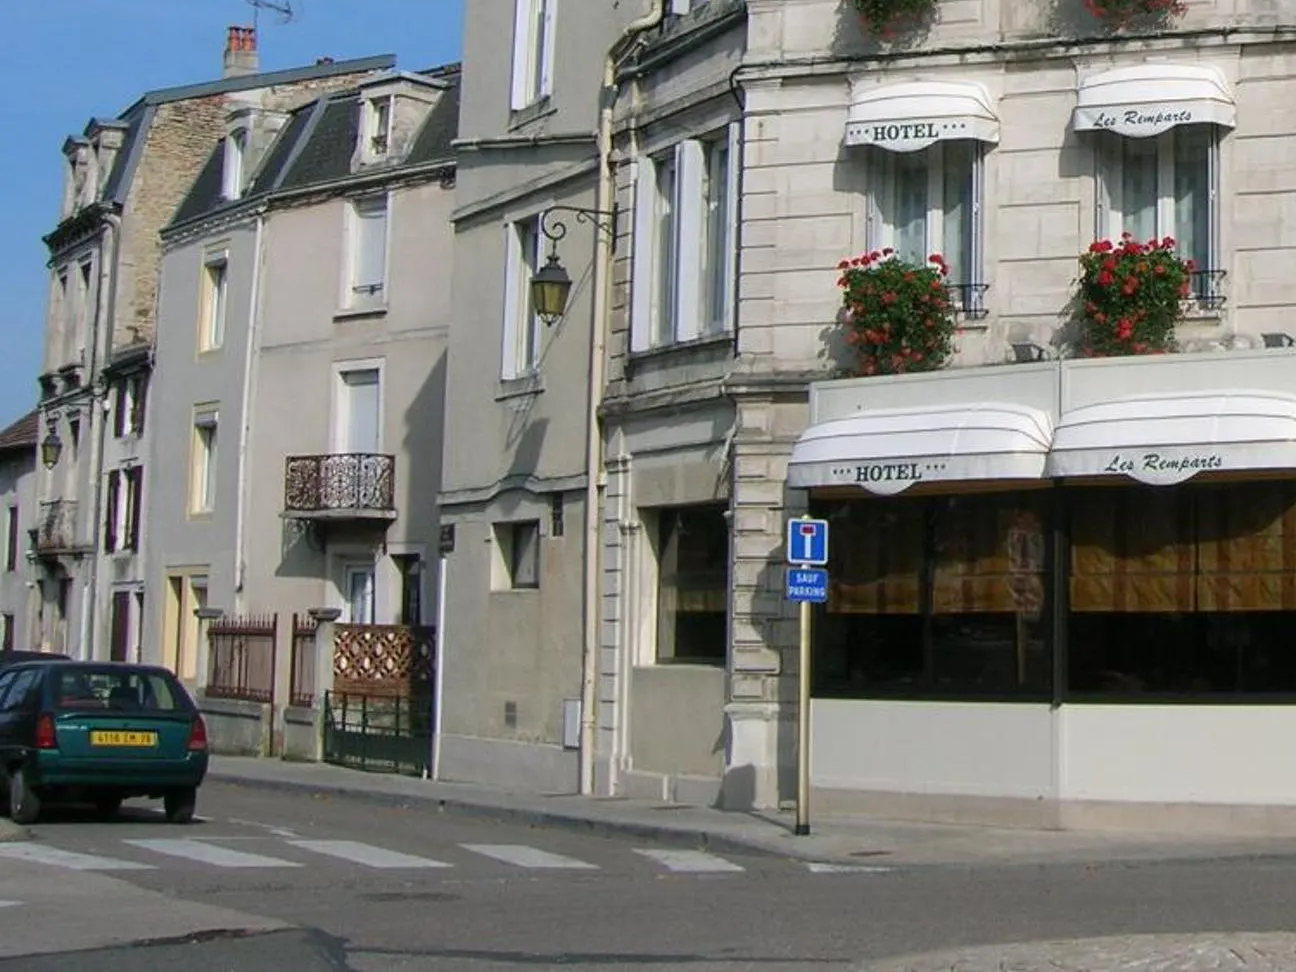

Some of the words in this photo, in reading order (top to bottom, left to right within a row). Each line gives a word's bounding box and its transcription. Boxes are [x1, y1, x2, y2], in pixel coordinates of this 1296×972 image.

[1093, 112, 1117, 127] Les
[1124, 110, 1192, 127] Remparts
[872, 123, 939, 141] HOTEL
[1105, 455, 1134, 472] Les
[1143, 453, 1222, 472] Remparts
[855, 463, 922, 482] HOTEL
